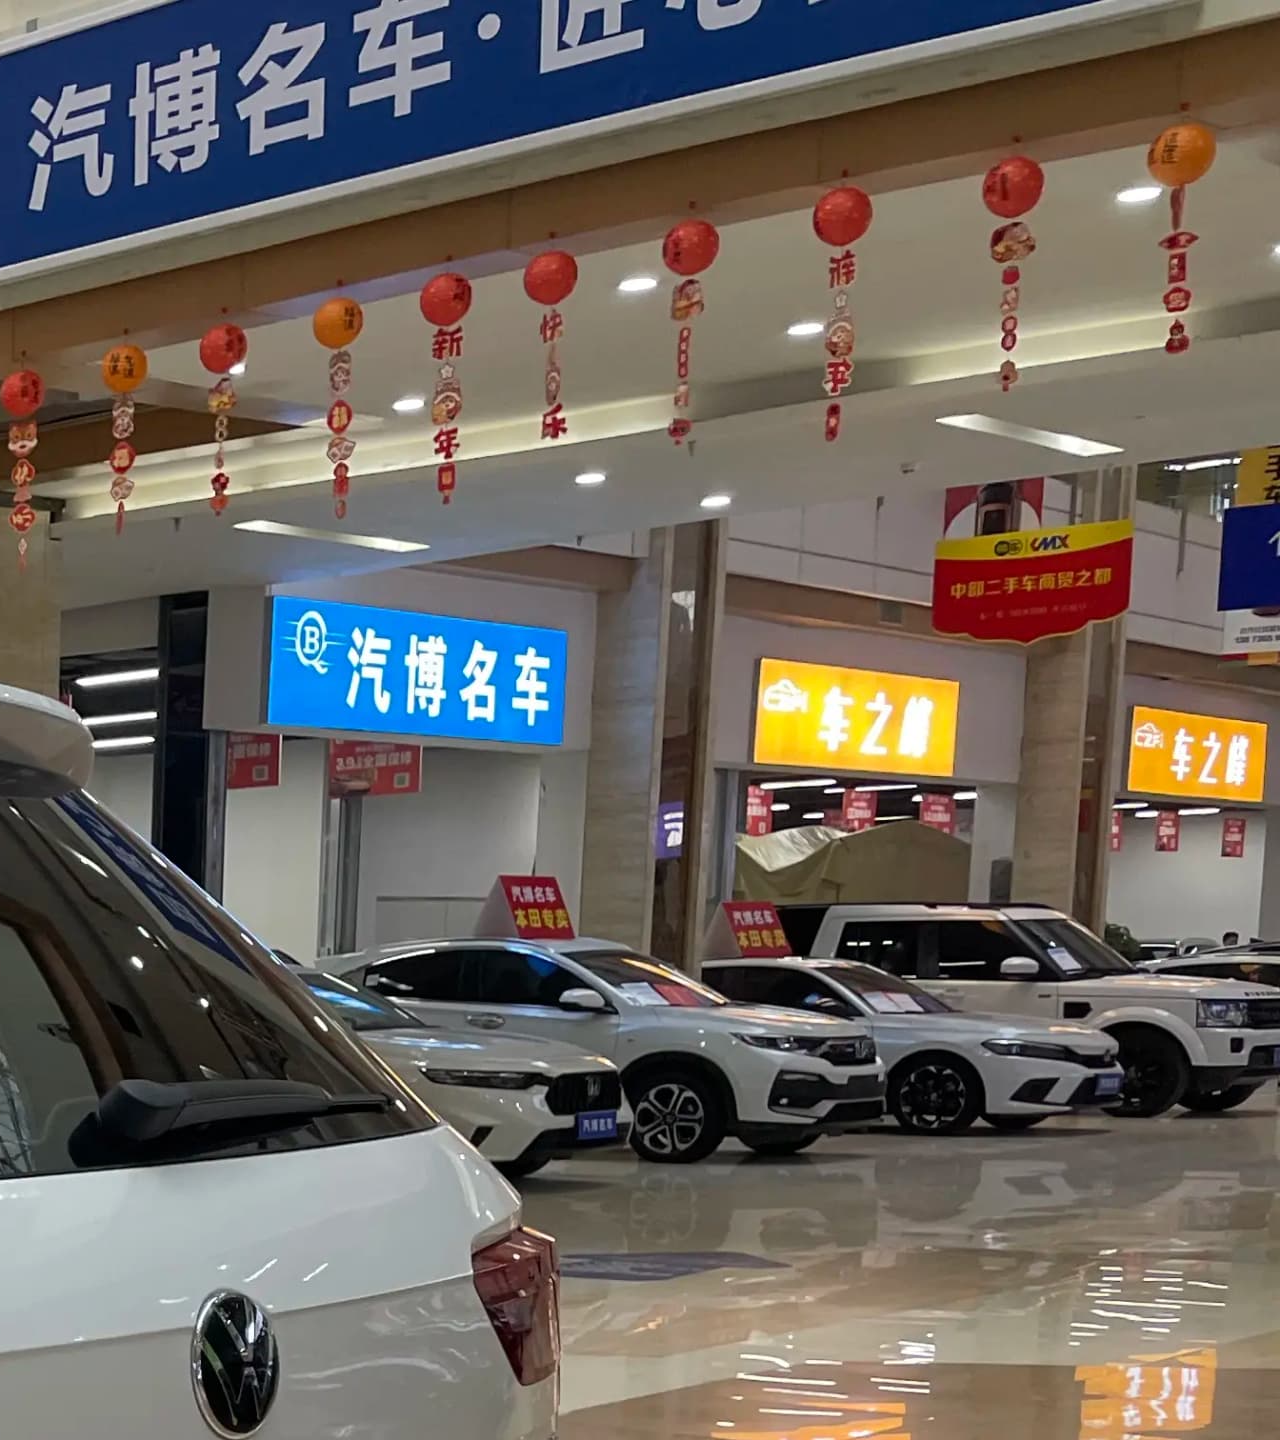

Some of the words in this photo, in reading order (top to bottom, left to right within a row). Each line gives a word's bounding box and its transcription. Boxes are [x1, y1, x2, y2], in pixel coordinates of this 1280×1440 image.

[28, 0, 760, 211] 汽博名车·匠
[346, 627, 550, 726] 汽博名车
